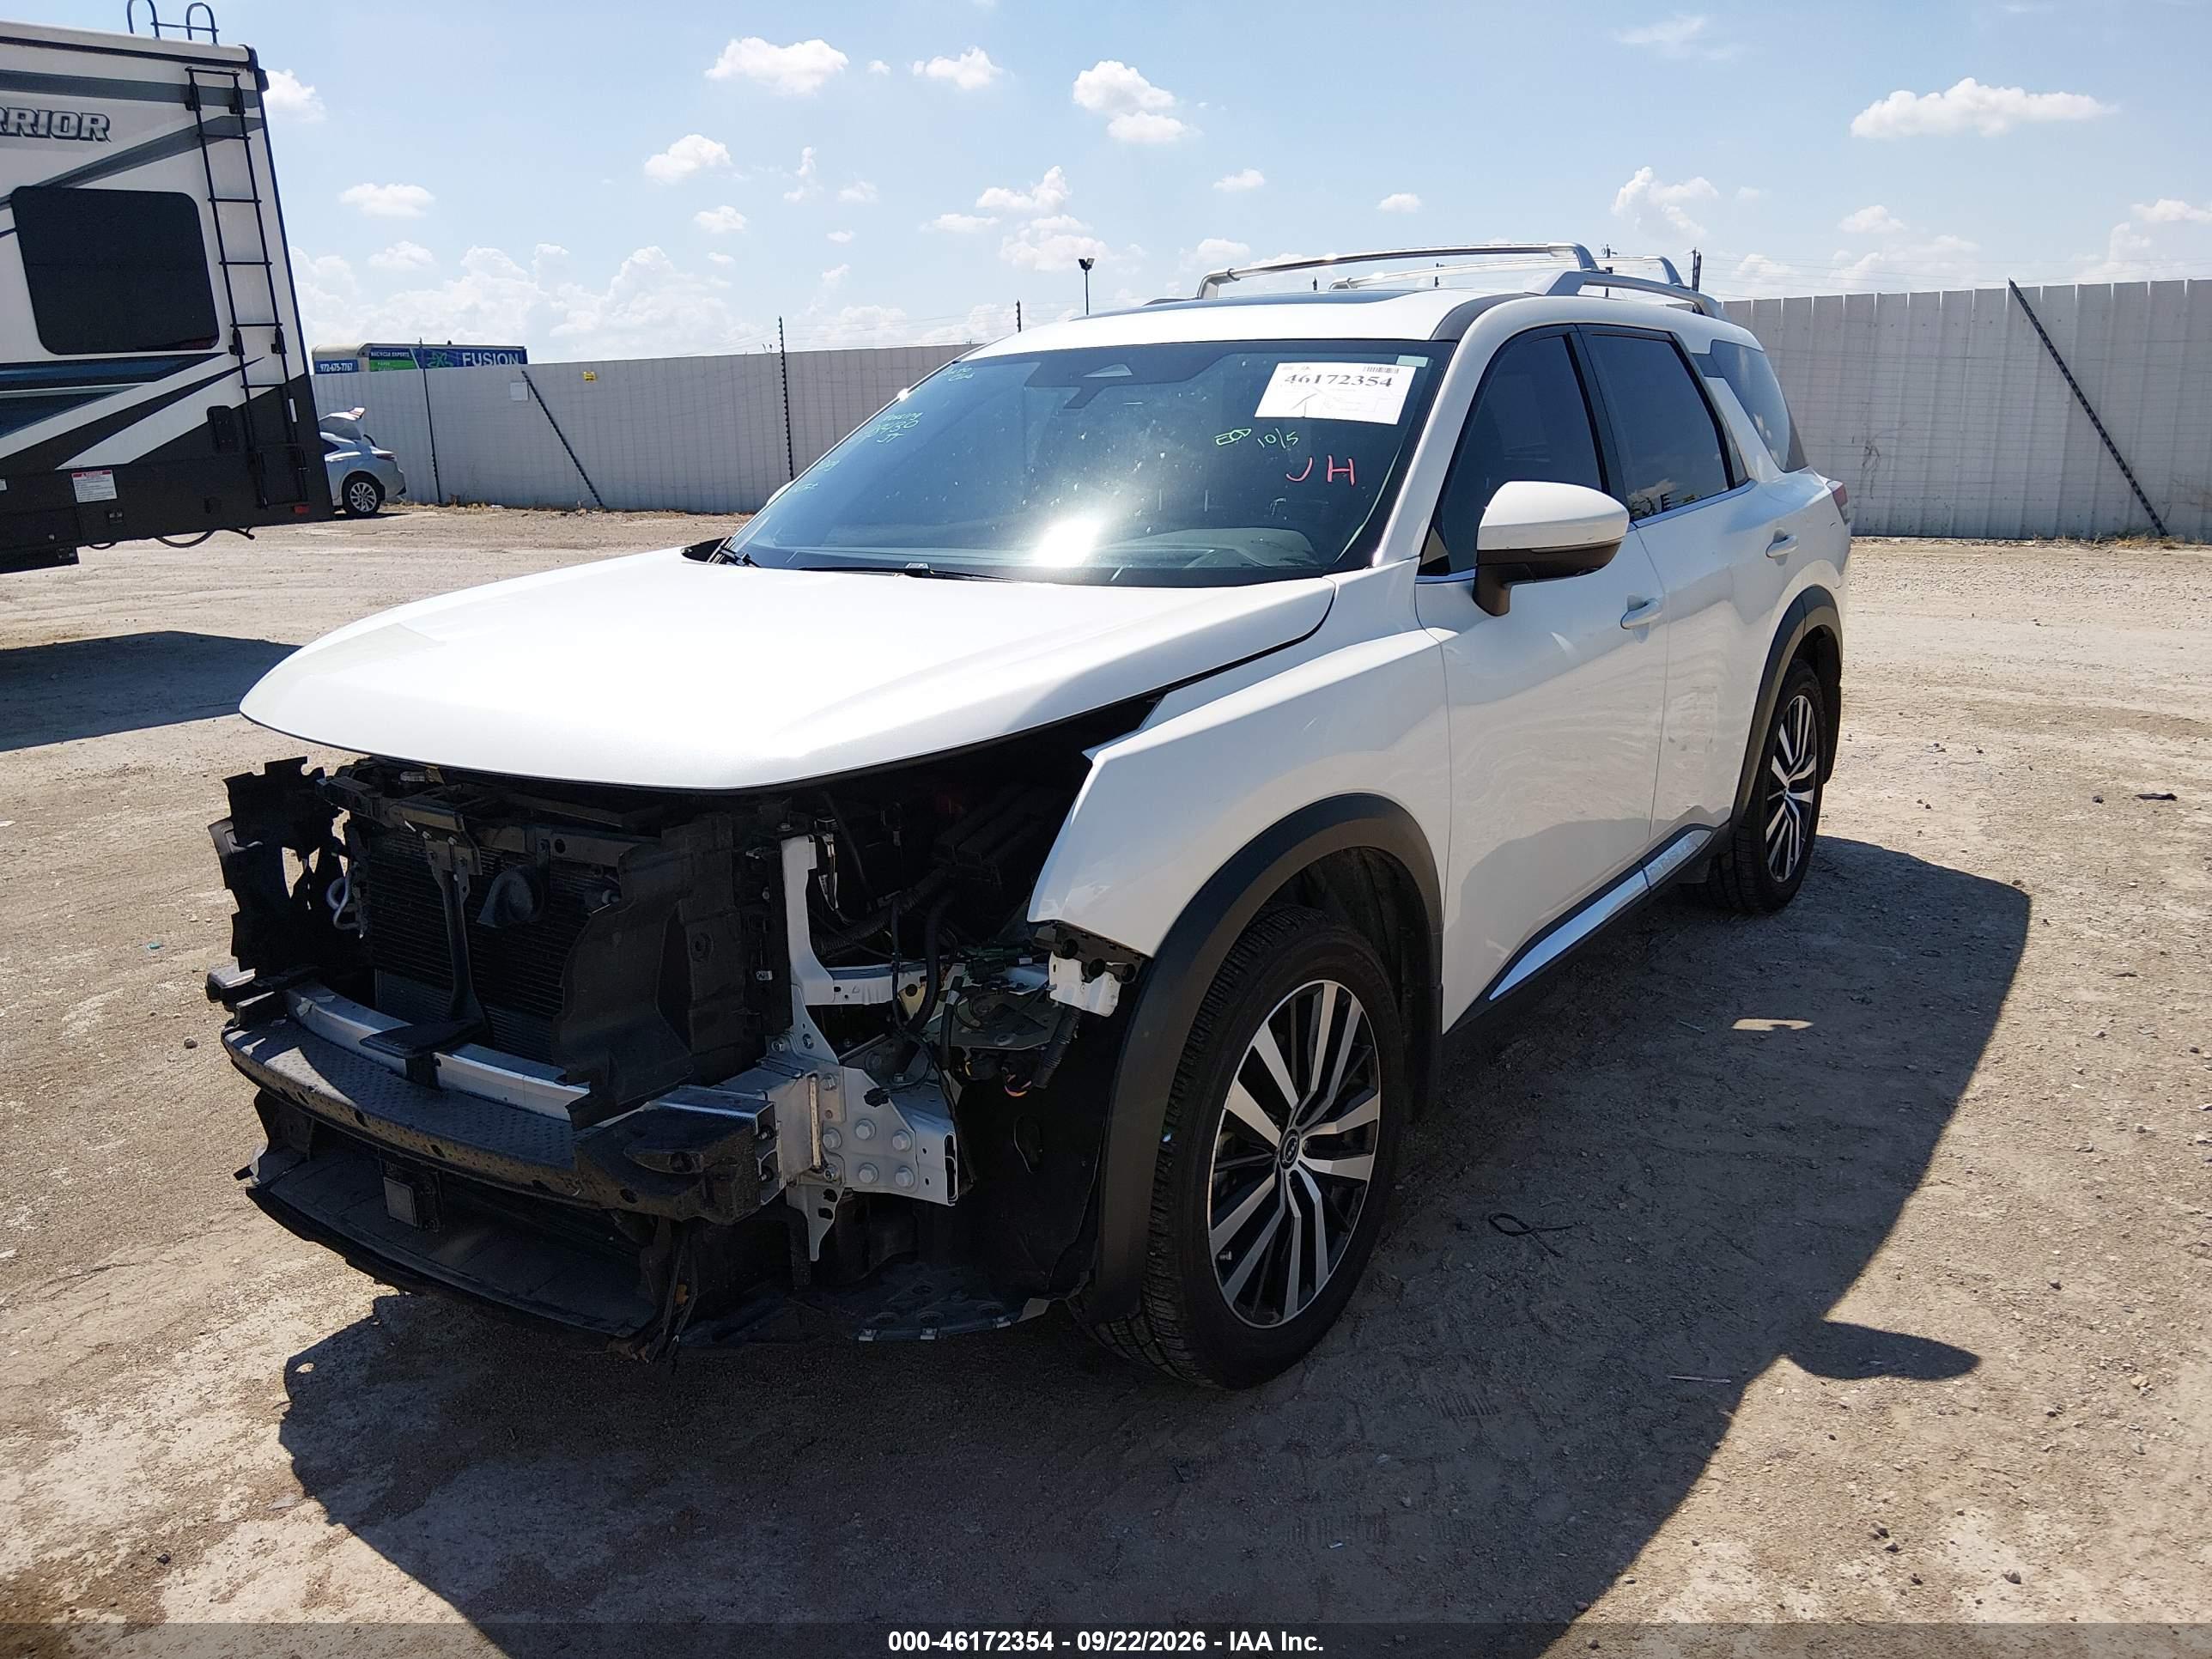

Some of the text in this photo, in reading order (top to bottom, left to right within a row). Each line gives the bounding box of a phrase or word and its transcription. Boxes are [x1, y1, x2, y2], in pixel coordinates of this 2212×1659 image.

[0, 106, 112, 143] RIOR
[462, 352, 519, 367] FUSION
[1285, 374, 1393, 387] 46172354
